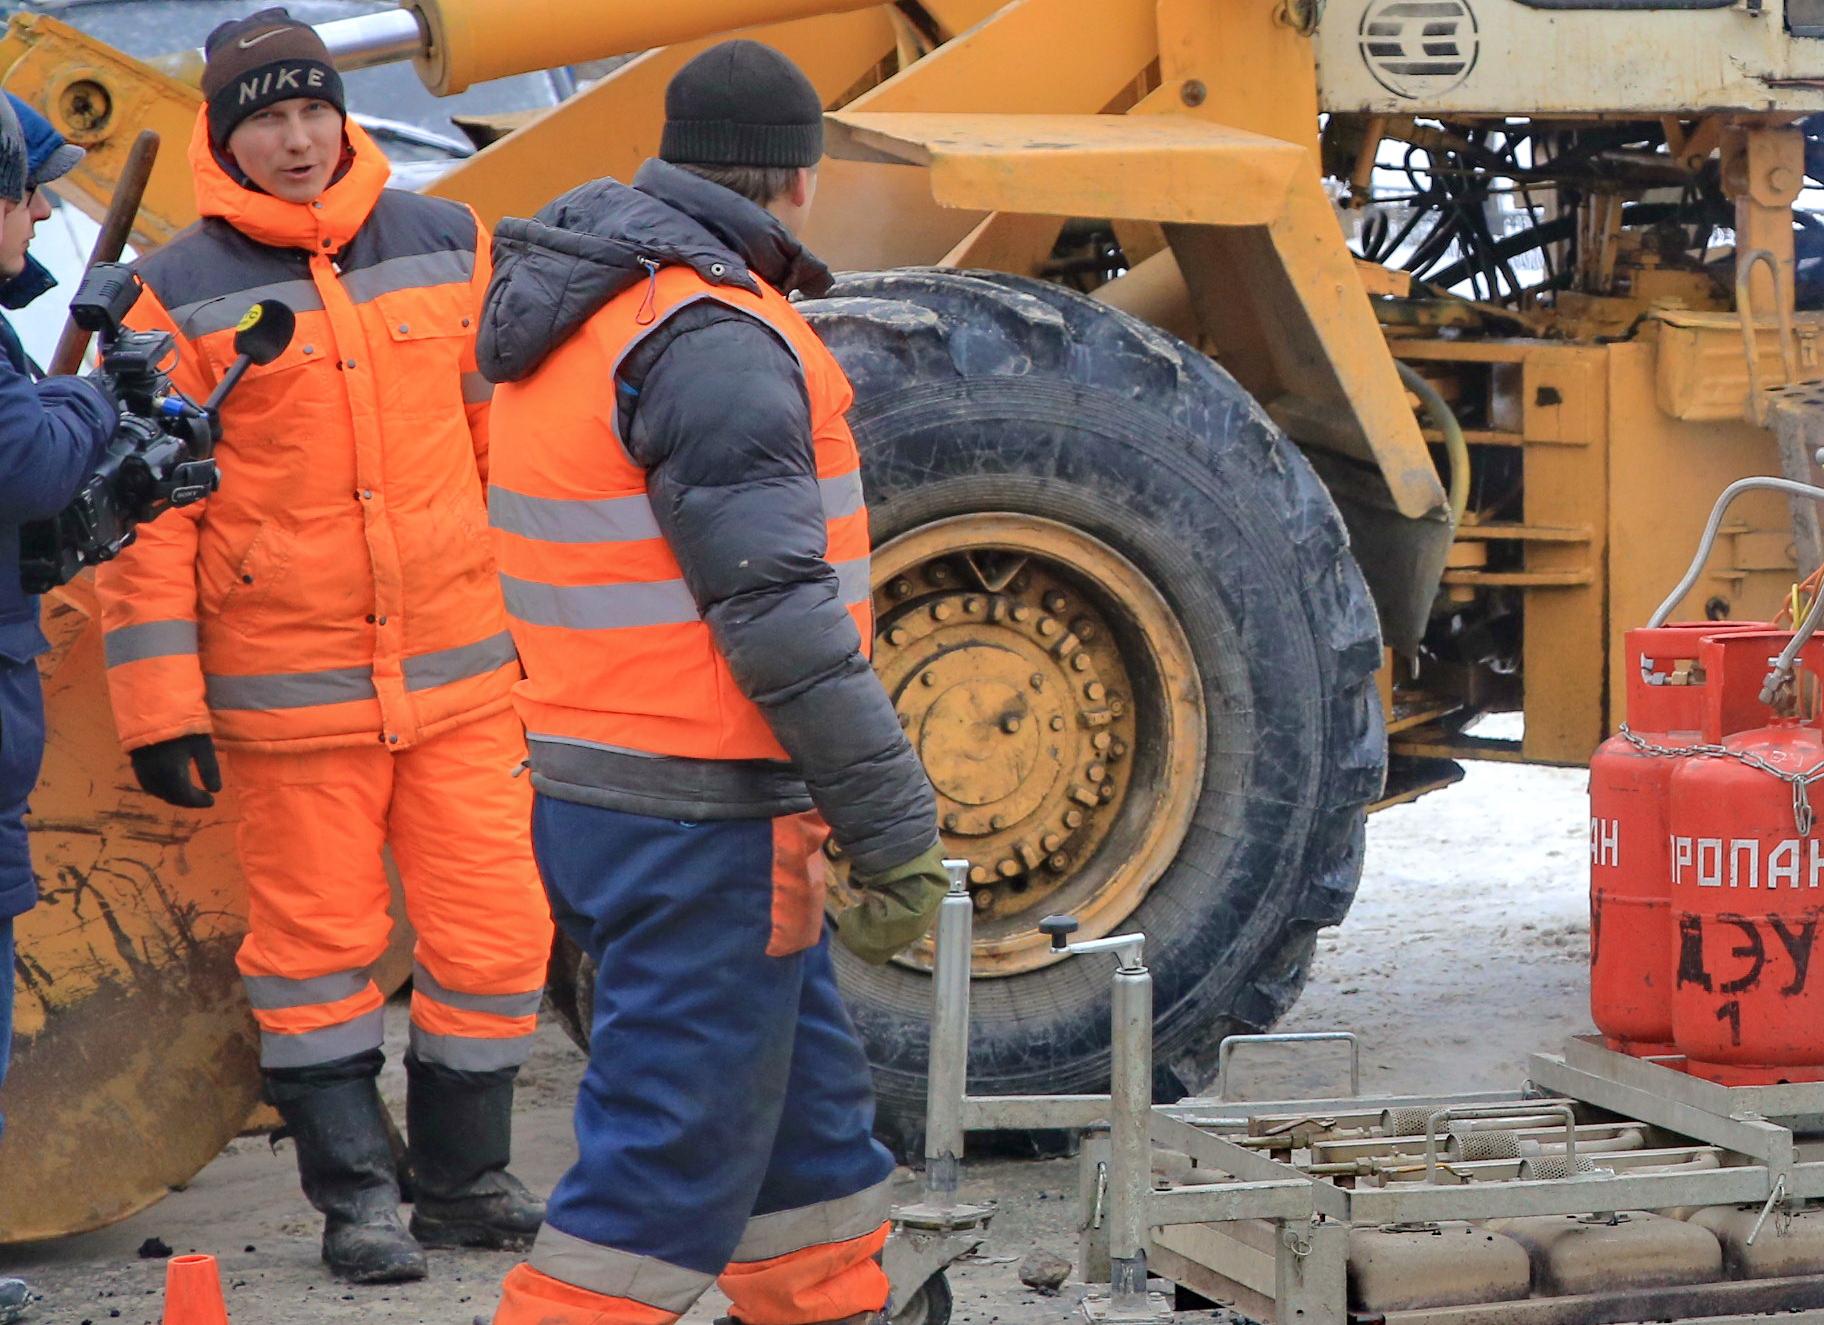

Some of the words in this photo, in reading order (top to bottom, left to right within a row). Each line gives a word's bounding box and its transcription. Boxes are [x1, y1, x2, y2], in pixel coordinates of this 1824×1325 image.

[239, 67, 325, 105] NIKE
[1677, 910, 1822, 995] ДЭУ
[1716, 1000, 1740, 1047] 1
